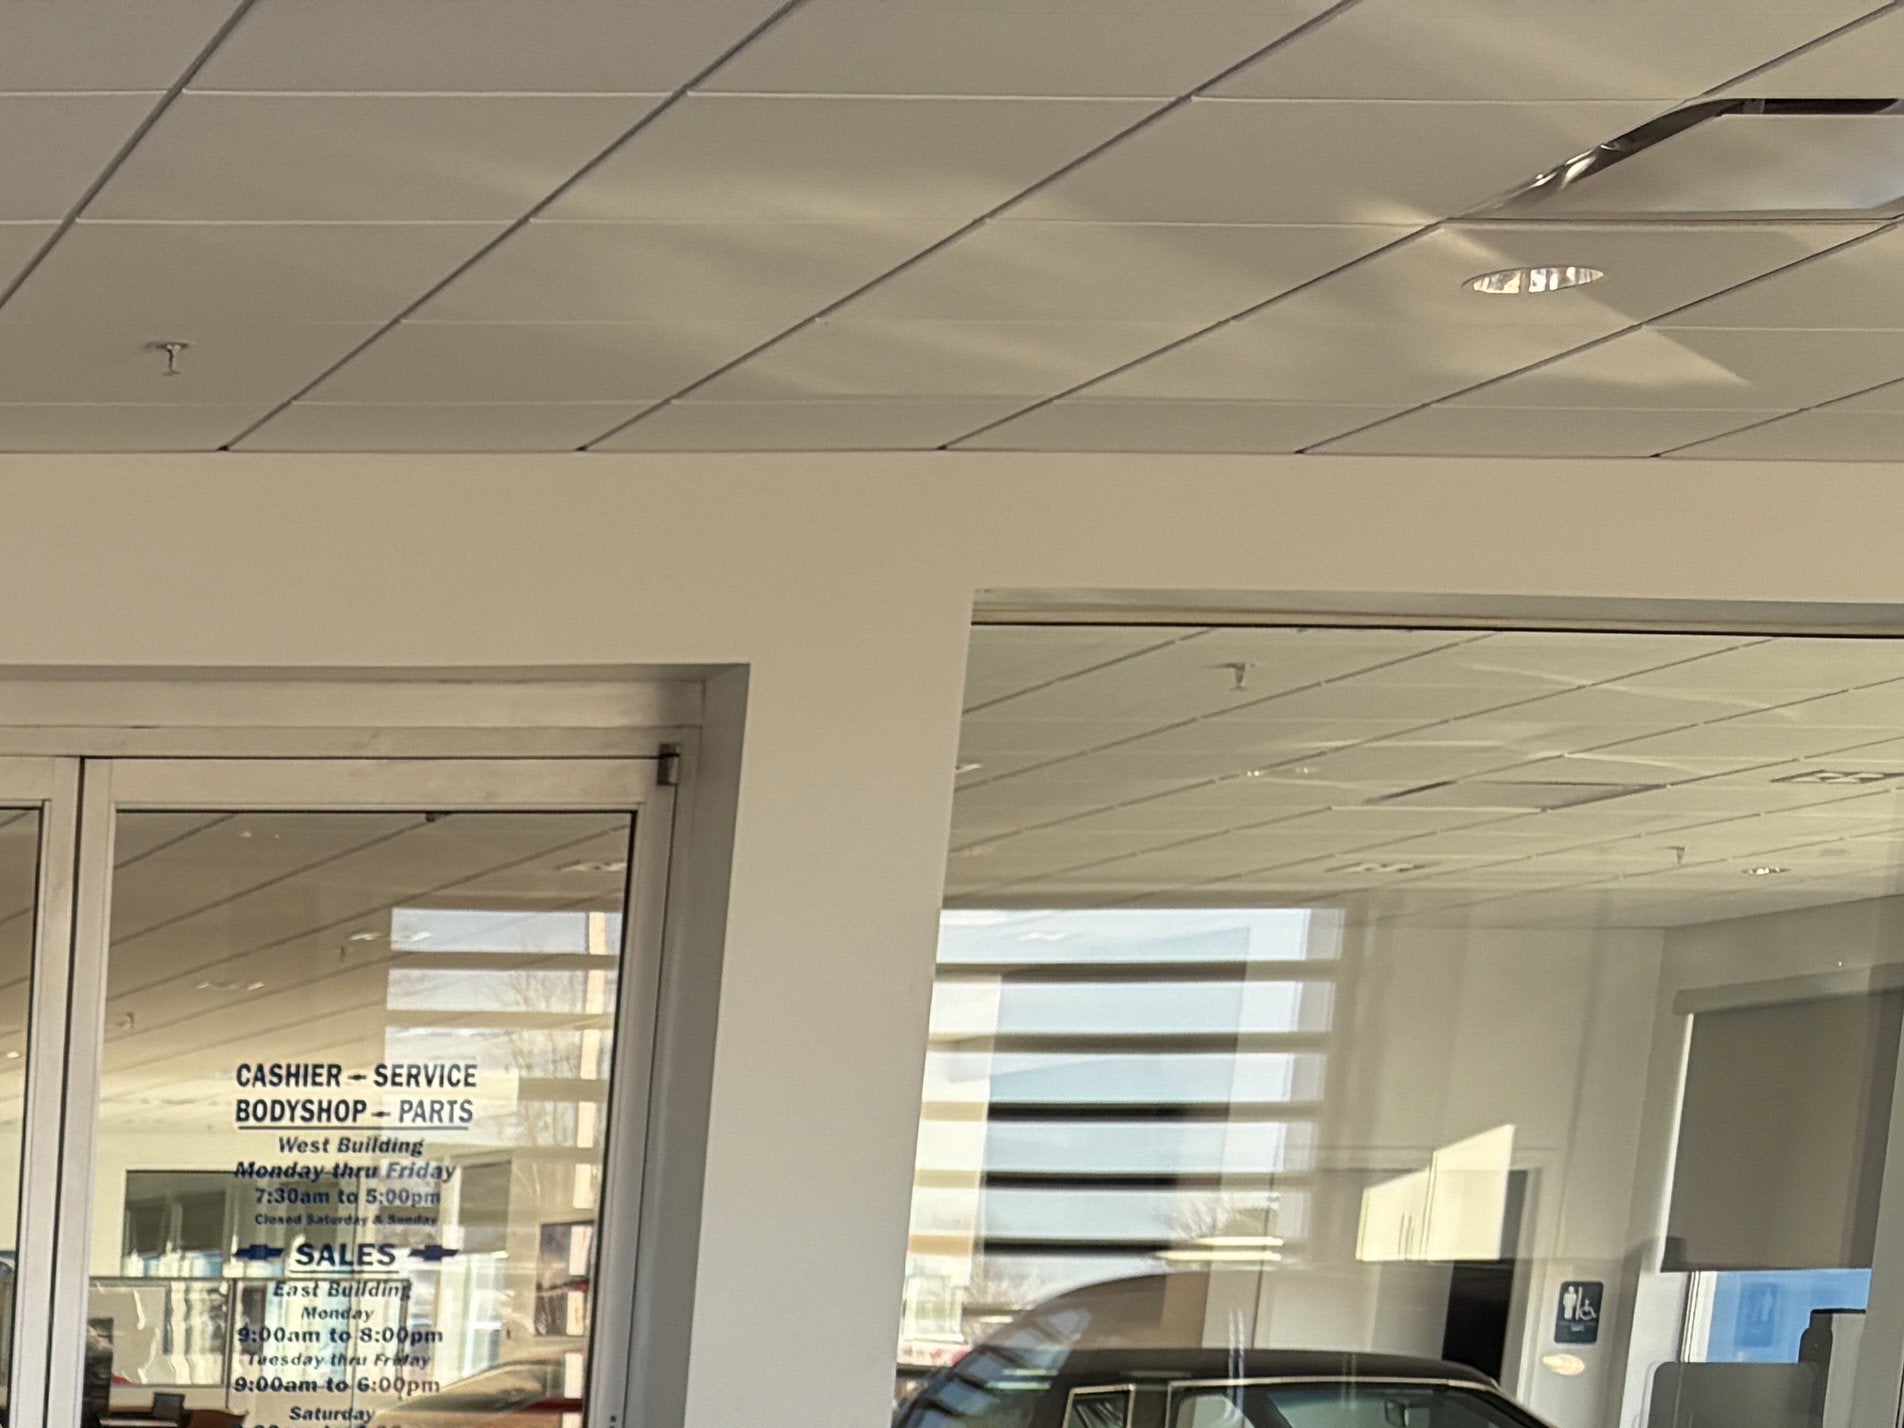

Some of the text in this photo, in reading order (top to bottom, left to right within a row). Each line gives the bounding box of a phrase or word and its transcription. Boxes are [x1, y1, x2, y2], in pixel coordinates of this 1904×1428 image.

[236, 1063, 478, 1088] CASHIER SERVICE
[235, 1099, 474, 1124] BODYSHOP PARTS
[278, 1136, 425, 1157] West Building
[234, 1161, 457, 1183] Monday thru Friday
[255, 1188, 442, 1208] 7:30am to 5:00pm
[255, 1214, 302, 1226] Closed
[307, 1214, 369, 1227] Saturday
[388, 1214, 438, 1227] Sunday
[294, 1242, 397, 1266] SALES
[273, 1280, 412, 1300] East Building
[301, 1306, 374, 1322] Monday
[237, 1327, 444, 1346] 9:00am to 8:00pm
[248, 1352, 432, 1370] Tuesday thru Friday
[233, 1376, 440, 1396] 9:00am to 6:00pm
[289, 1406, 375, 1423] Saturday
